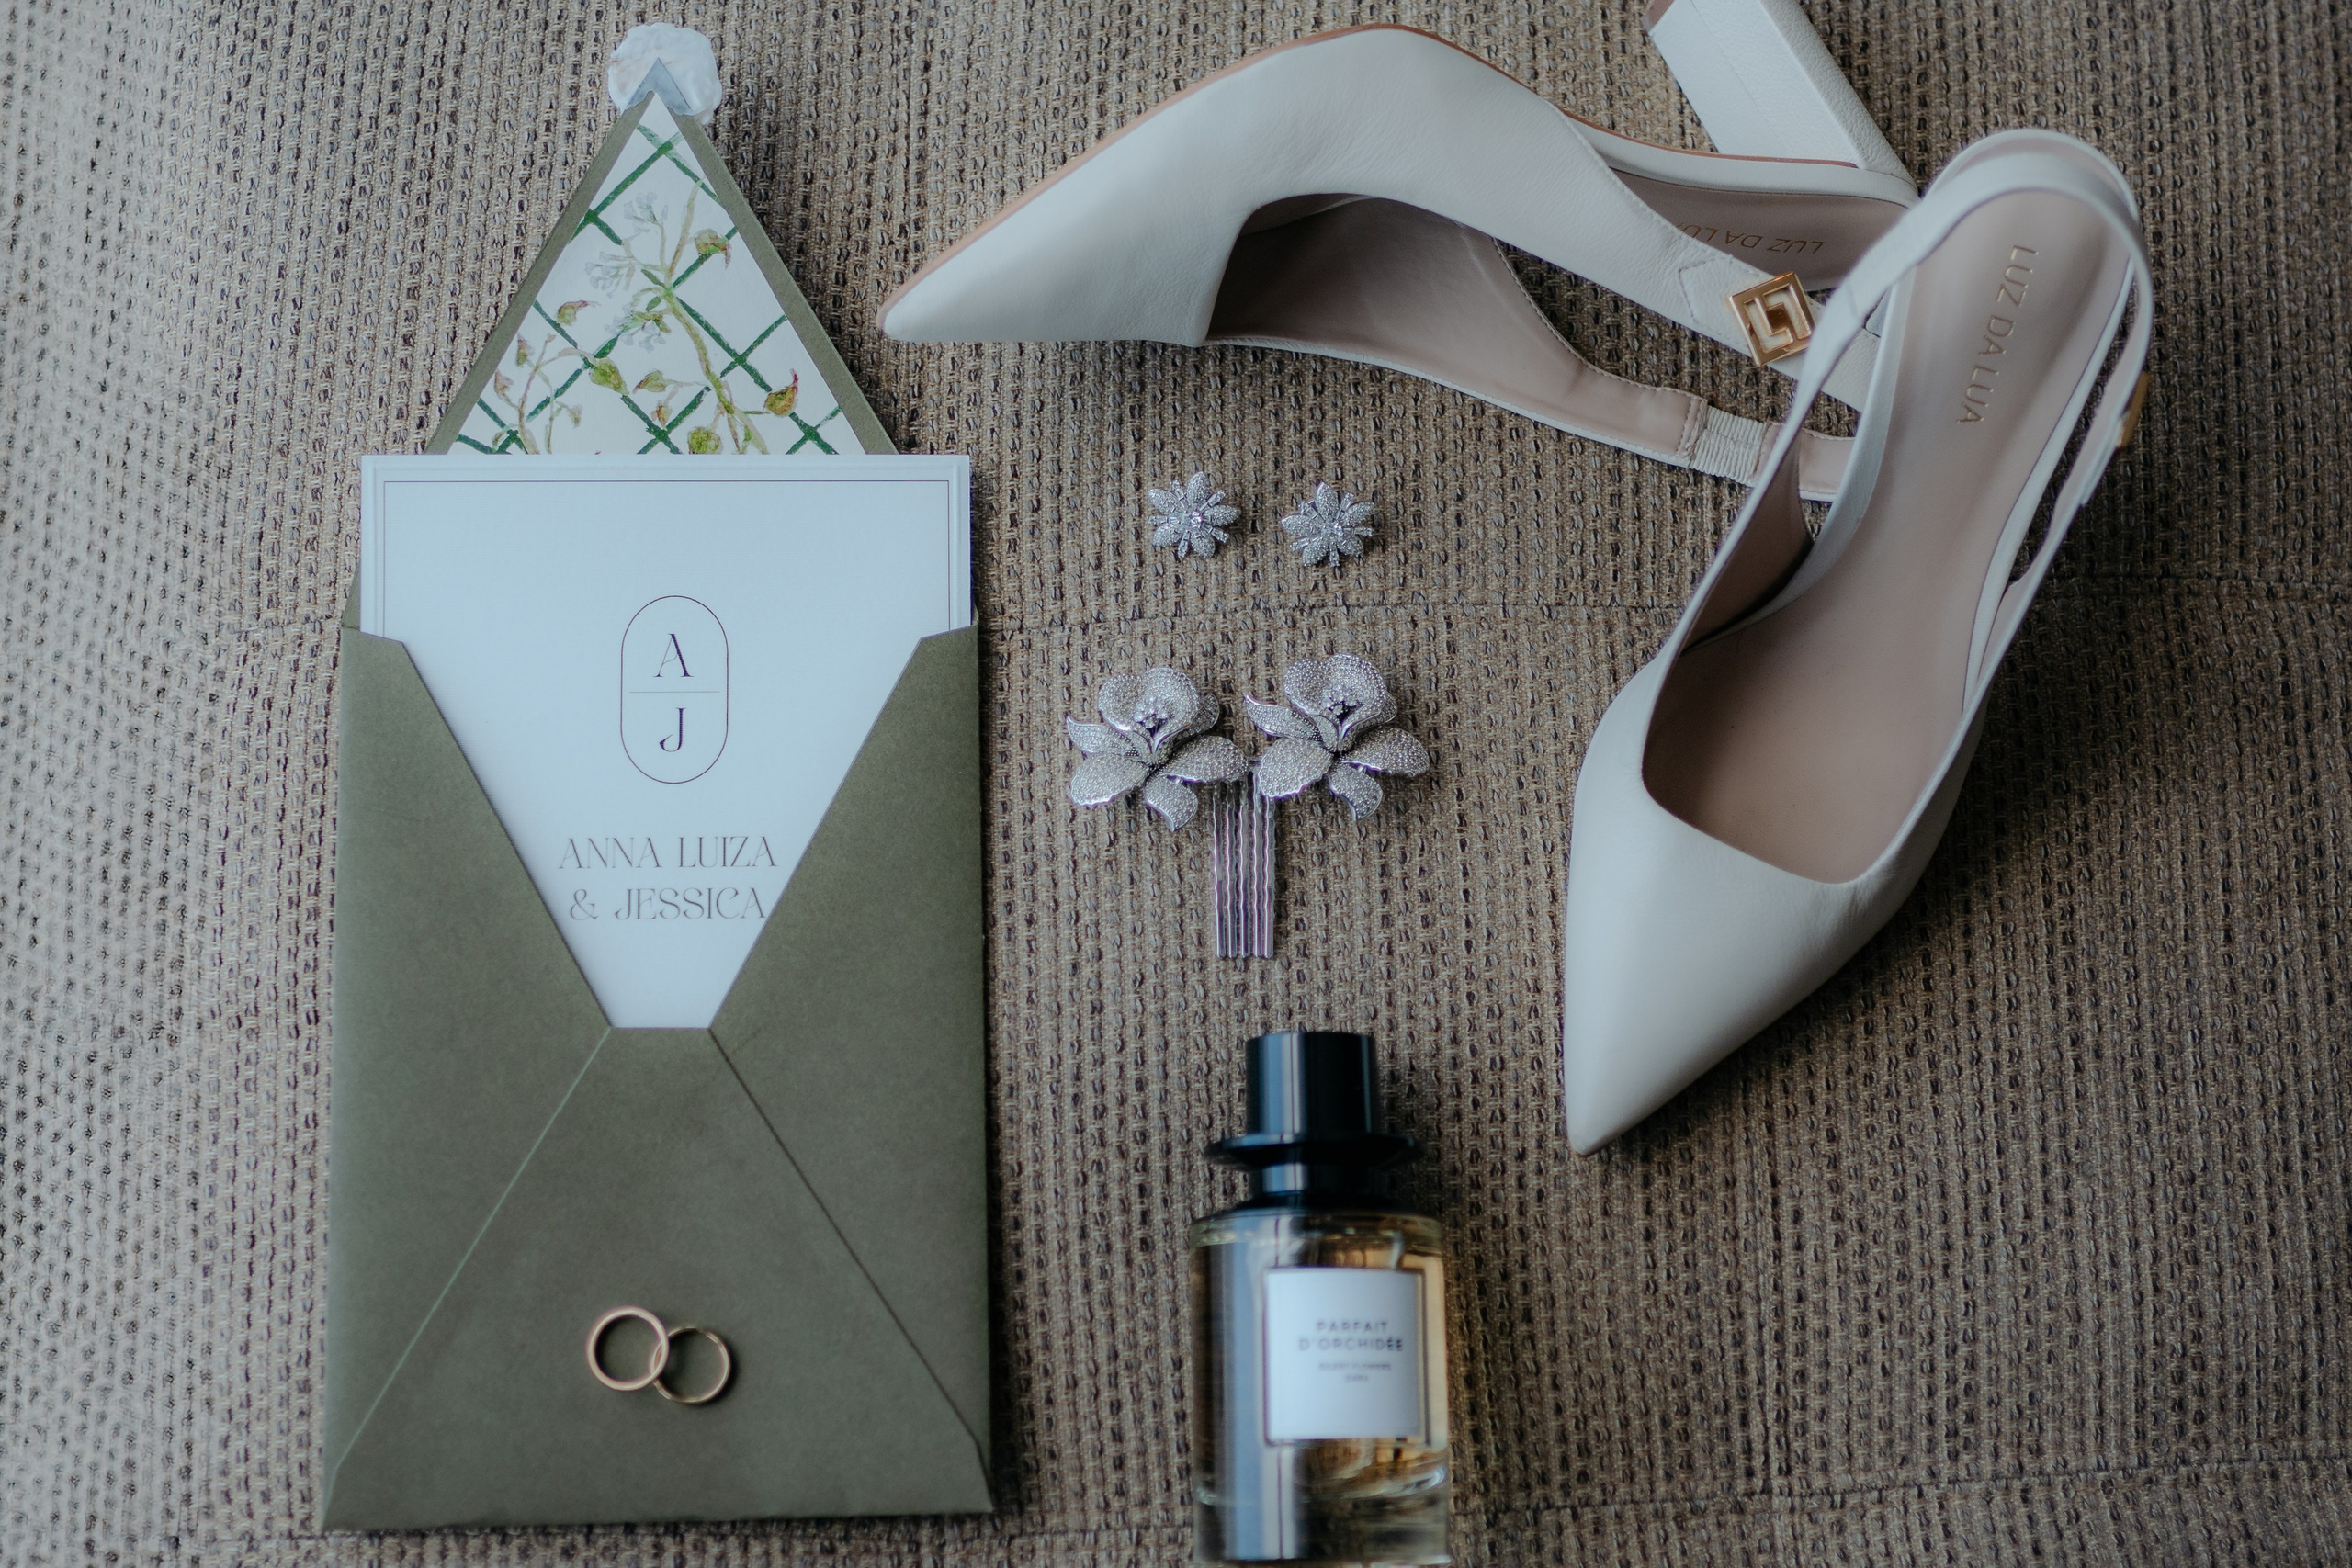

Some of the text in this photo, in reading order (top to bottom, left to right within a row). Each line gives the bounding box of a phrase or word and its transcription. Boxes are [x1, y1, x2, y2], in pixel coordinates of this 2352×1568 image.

[1677, 222, 1825, 254] LUZ DA LU
[1957, 245, 2039, 424] LUZ DA LUA
[653, 633, 694, 677] A
[659, 707, 686, 752] J
[559, 836, 777, 869] ANNA LUIZA
[570, 886, 765, 920] & JESSICA
[1317, 1321, 1388, 1332] PARFAIT
